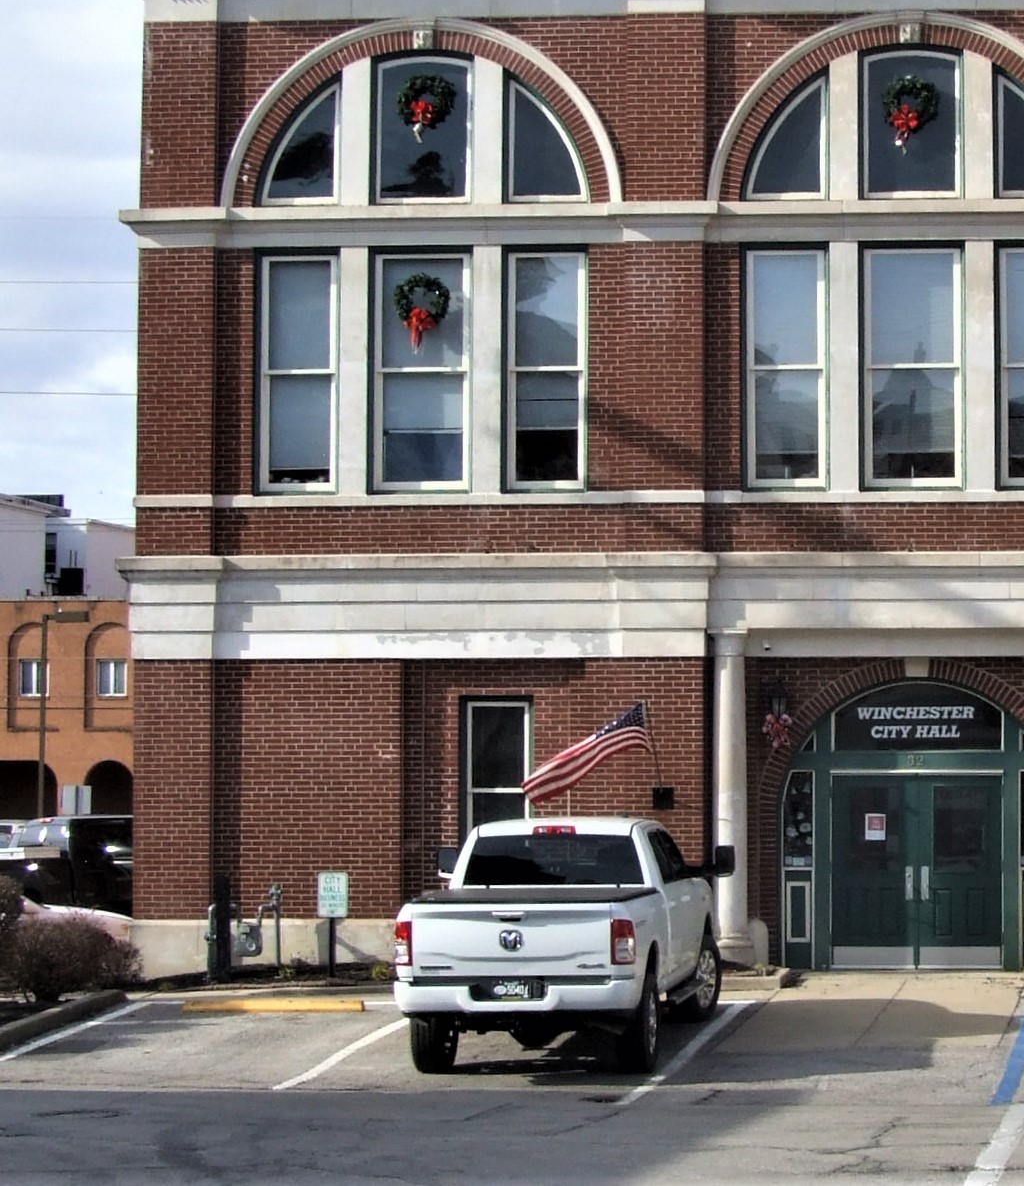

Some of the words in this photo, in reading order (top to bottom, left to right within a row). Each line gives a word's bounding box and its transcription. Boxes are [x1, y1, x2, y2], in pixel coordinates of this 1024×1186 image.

[857, 706, 975, 720] WINCHESTER
[871, 725, 911, 738] CITY
[915, 725, 960, 738] HALL
[325, 875, 341, 884] CITY
